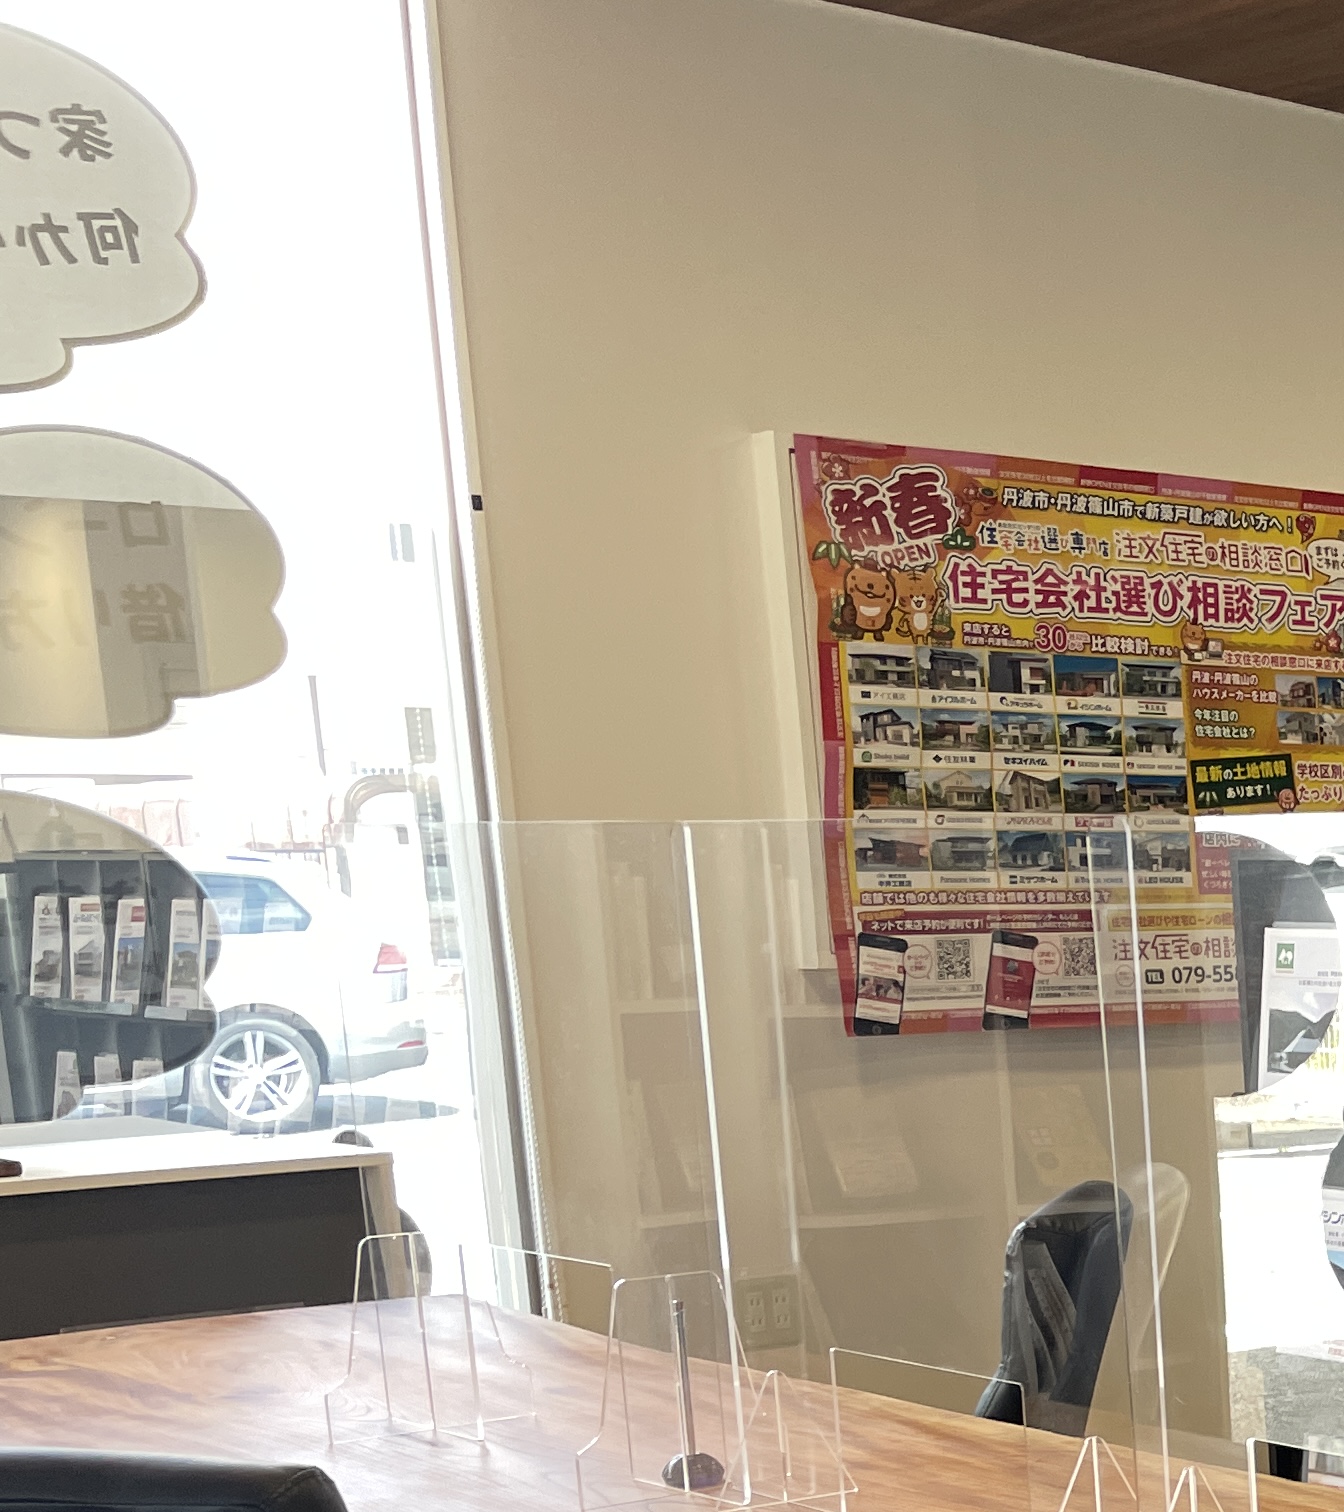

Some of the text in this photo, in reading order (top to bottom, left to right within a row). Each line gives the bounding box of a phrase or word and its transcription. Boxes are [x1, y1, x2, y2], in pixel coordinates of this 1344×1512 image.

[829, 471, 952, 551] 新春
[880, 542, 932, 567] OPEN
[1315, 545, 1339, 557] まずは
[1035, 623, 1067, 652] 30
[1194, 708, 1239, 722] 今年注目の
[1195, 760, 1287, 783] 最新の土地情報
